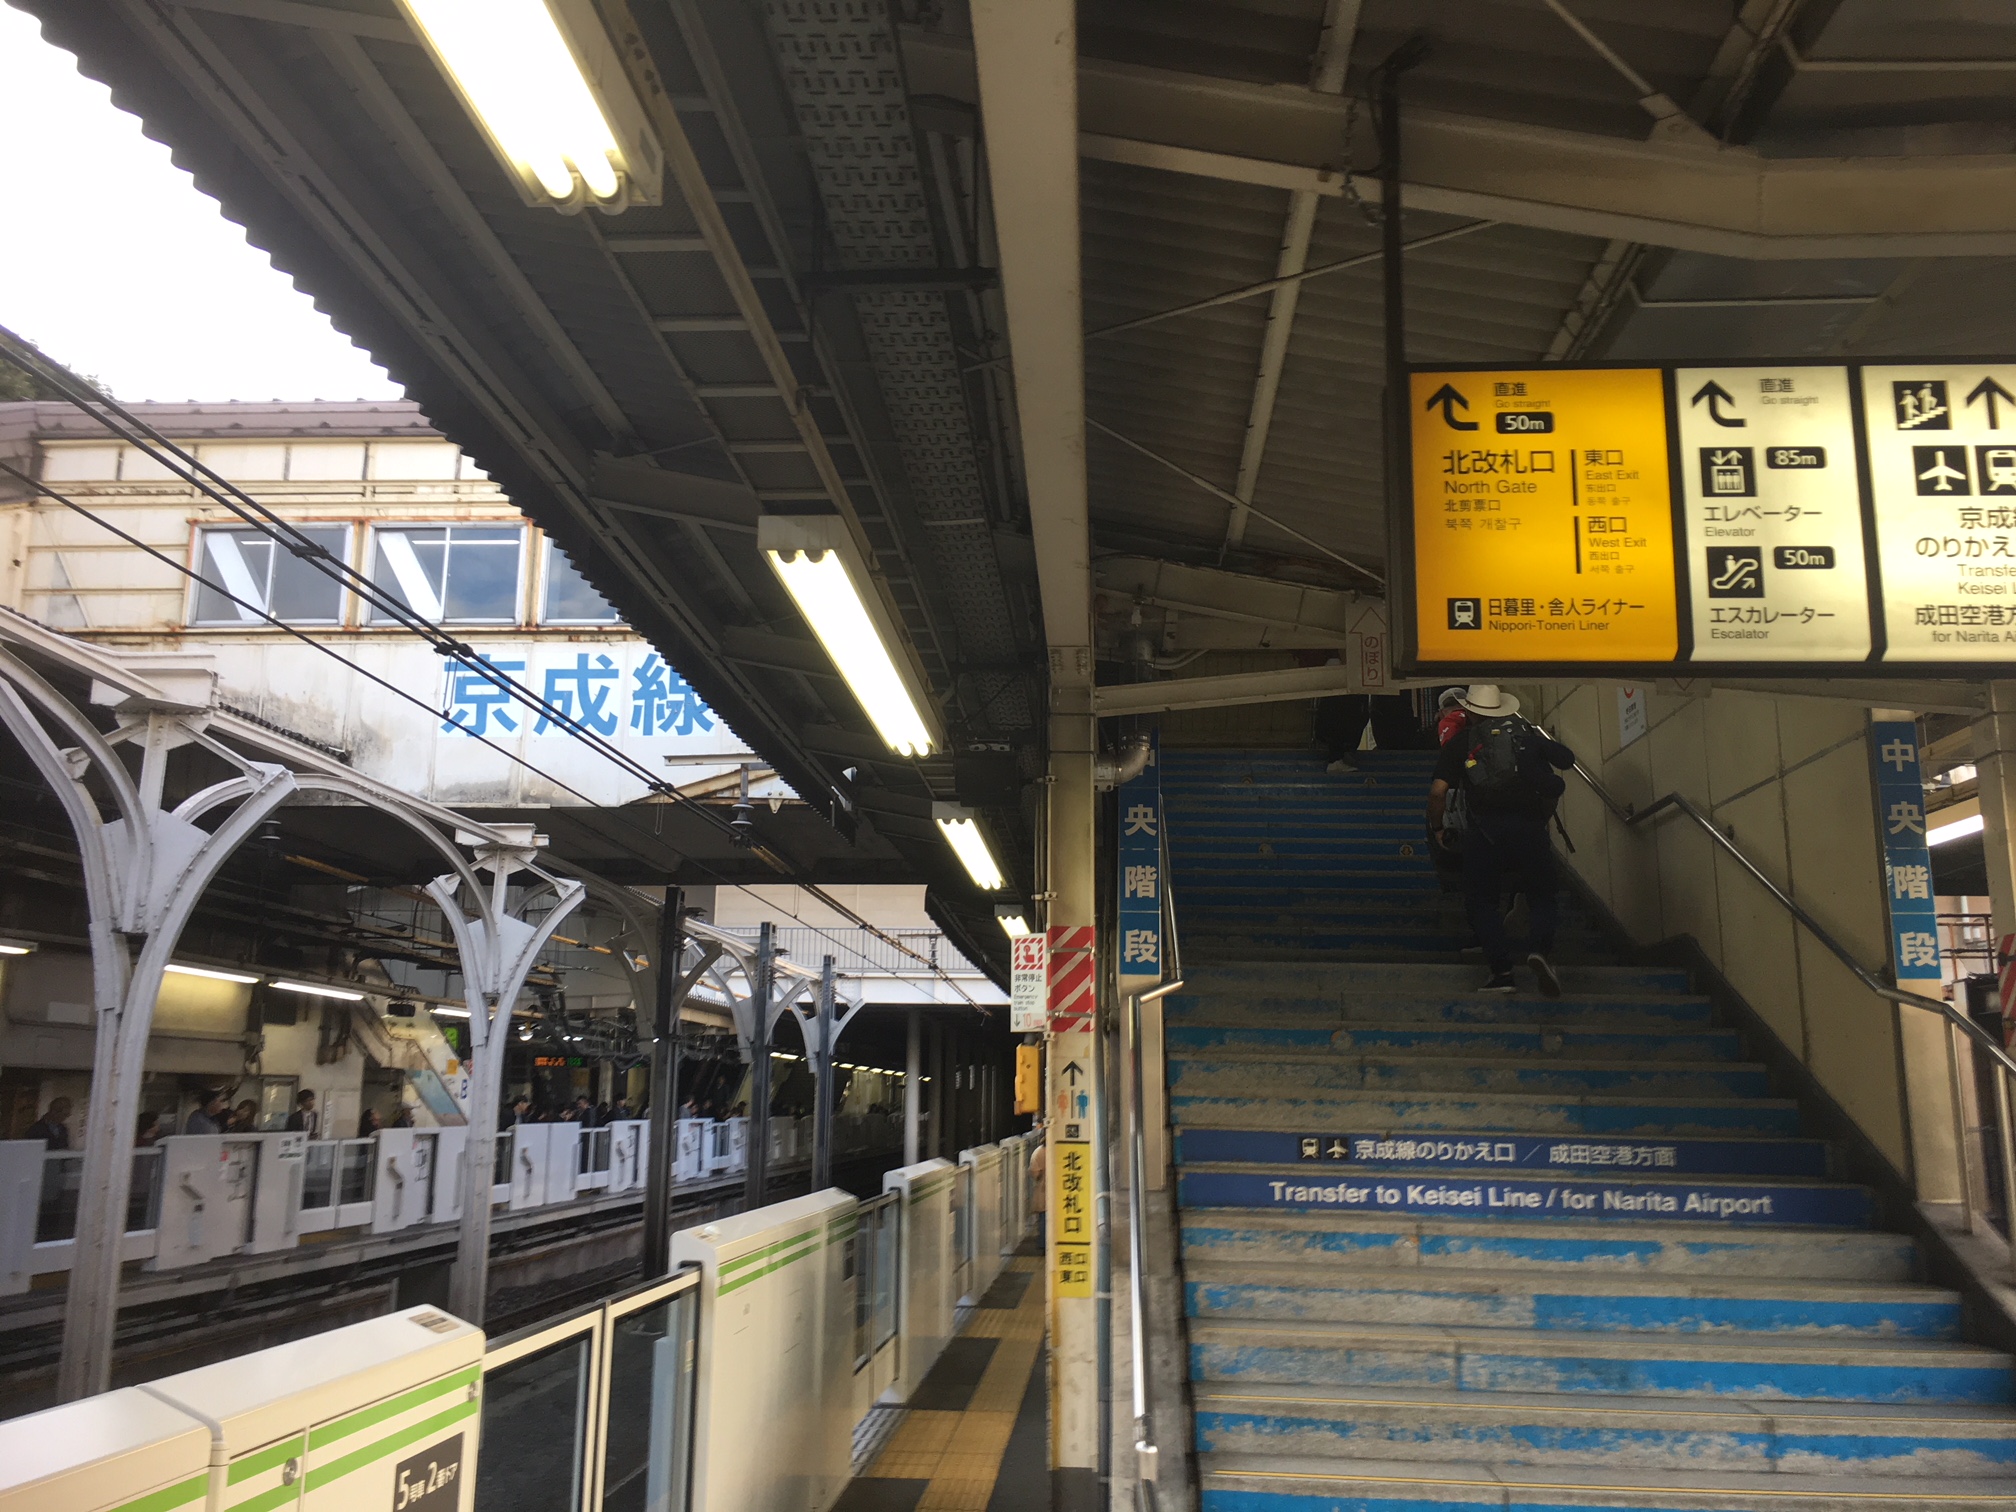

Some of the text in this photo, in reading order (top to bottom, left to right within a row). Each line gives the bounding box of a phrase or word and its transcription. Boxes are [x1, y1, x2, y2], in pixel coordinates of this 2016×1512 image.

[1494, 382, 1528, 397] 直進
[1759, 378, 1795, 393] 直進
[1495, 400, 1551, 409] Go straight
[1761, 396, 1819, 406] Go straight
[1504, 415, 1545, 431] 50m
[1442, 449, 1555, 475] 北改札口
[1584, 449, 1624, 467] 東口
[1774, 450, 1817, 466] 85m
[1585, 469, 1640, 480] East Exit
[1444, 480, 1538, 494] North Gate
[1444, 499, 1501, 512] 北剪票口
[1704, 505, 1823, 522] エレベーター
[1958, 506, 2016, 530] 京成
[1587, 516, 1628, 533] 西口
[1705, 526, 1756, 538] Elevator
[1588, 537, 1648, 548] West Exit
[1783, 551, 1826, 566] 50m
[1958, 581, 2007, 595] Keisei
[1488, 598, 1645, 616] 日暮里・舎人ライナー
[1710, 606, 1836, 624] エスカレーター
[1488, 619, 1610, 632] Nippori-Toneri Liner
[1711, 628, 1770, 640] Escalator
[1933, 631, 1952, 643] for
[1956, 631, 2000, 643] Narita
[1364, 636, 1380, 681] のぼり
[440, 652, 715, 737] 京成線
[1123, 749, 1158, 963] 央階段
[1881, 738, 1939, 967] 中央階段
[1014, 973, 1042, 983] 非常停止
[1014, 984, 1035, 993] ボタン
[1354, 1139, 1516, 1162] 京成線のりかえ口
[1549, 1143, 1677, 1167] 成田空港方面
[1063, 1152, 1083, 1233] 北改札口
[1269, 1181, 1369, 1203] Transfer
[1375, 1184, 1401, 1205] to
[1407, 1184, 1482, 1207] Keisei
[1488, 1186, 1541, 1208] Line
[1560, 1187, 1597, 1210] for
[1603, 1189, 1678, 1212] Narita
[1683, 1191, 1774, 1218] Airport
[1059, 1252, 1088, 1265] 西口
[1059, 1270, 1088, 1283] 東口
